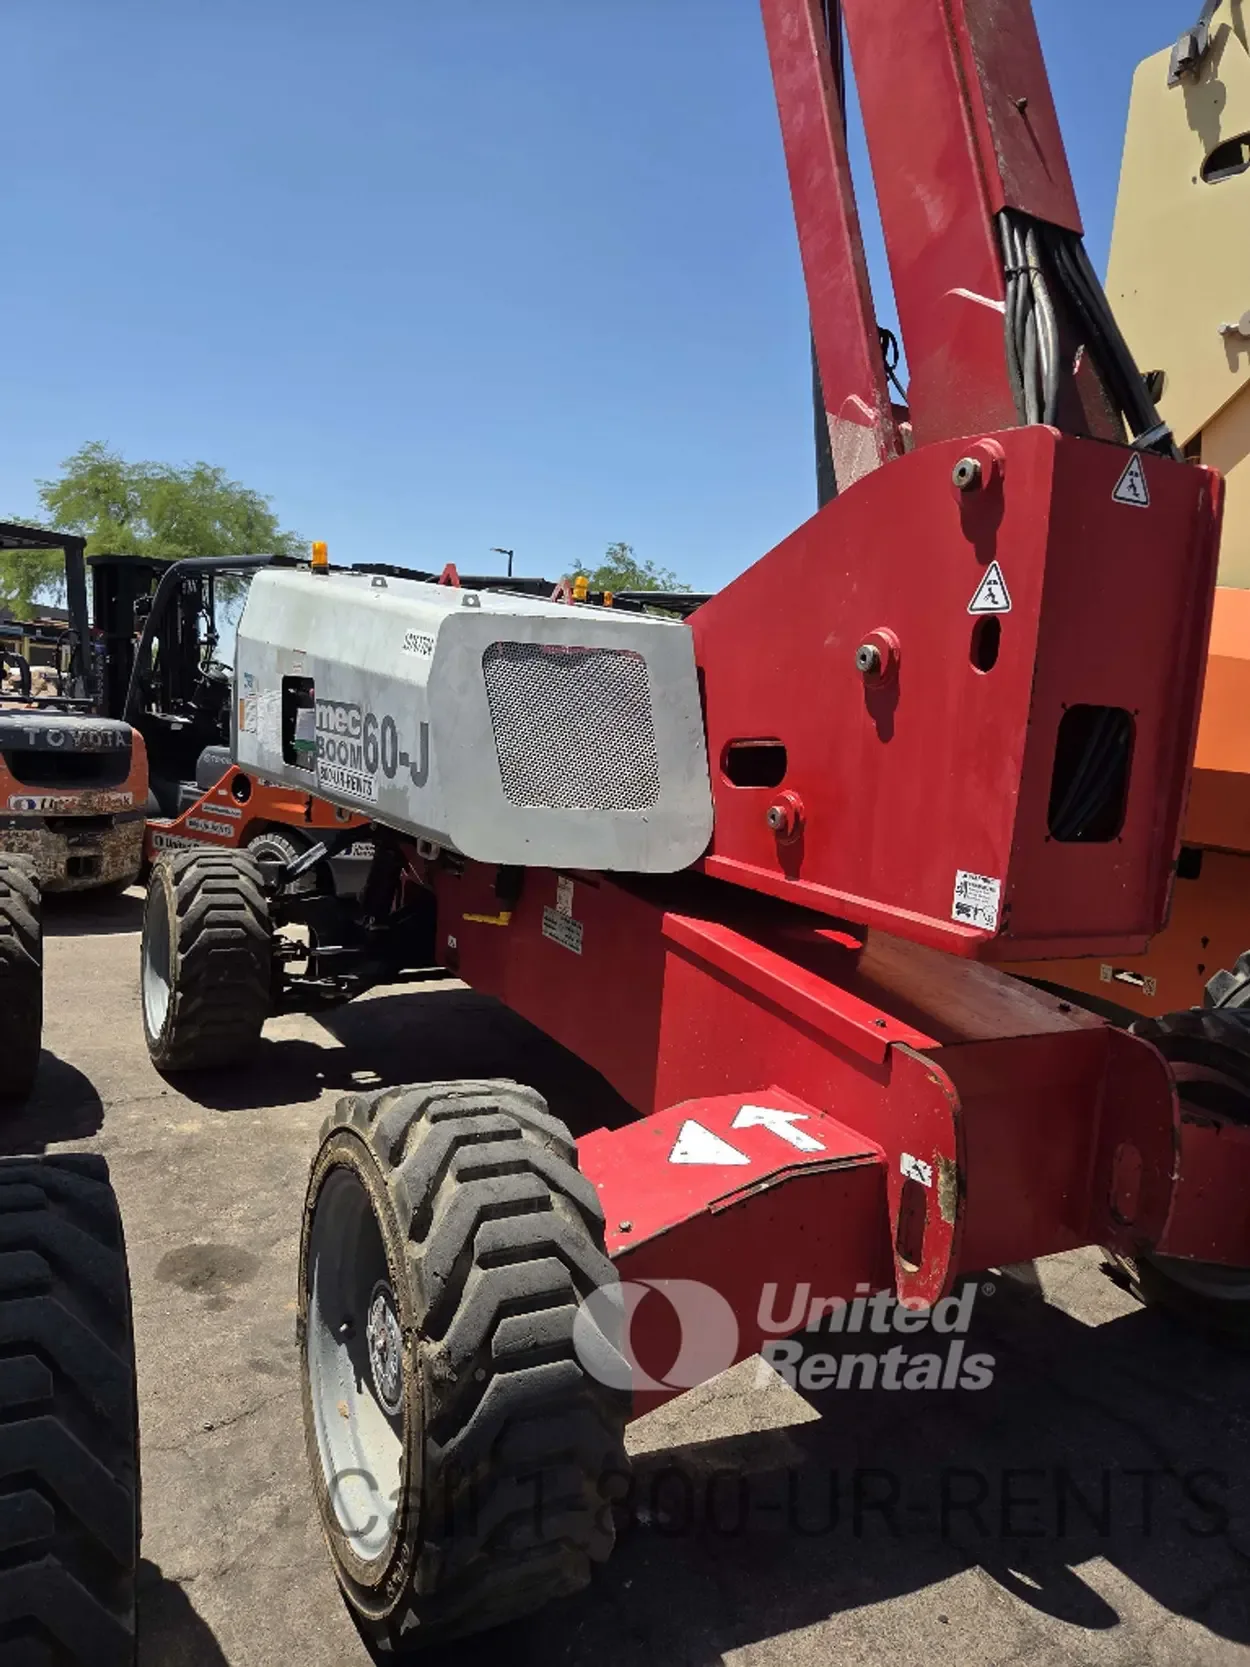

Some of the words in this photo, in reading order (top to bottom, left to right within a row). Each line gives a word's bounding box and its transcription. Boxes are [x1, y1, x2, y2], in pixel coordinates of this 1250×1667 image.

[316, 702, 361, 736] mec
[23, 727, 126, 747] TOYOTA
[316, 735, 362, 771] BOOM
